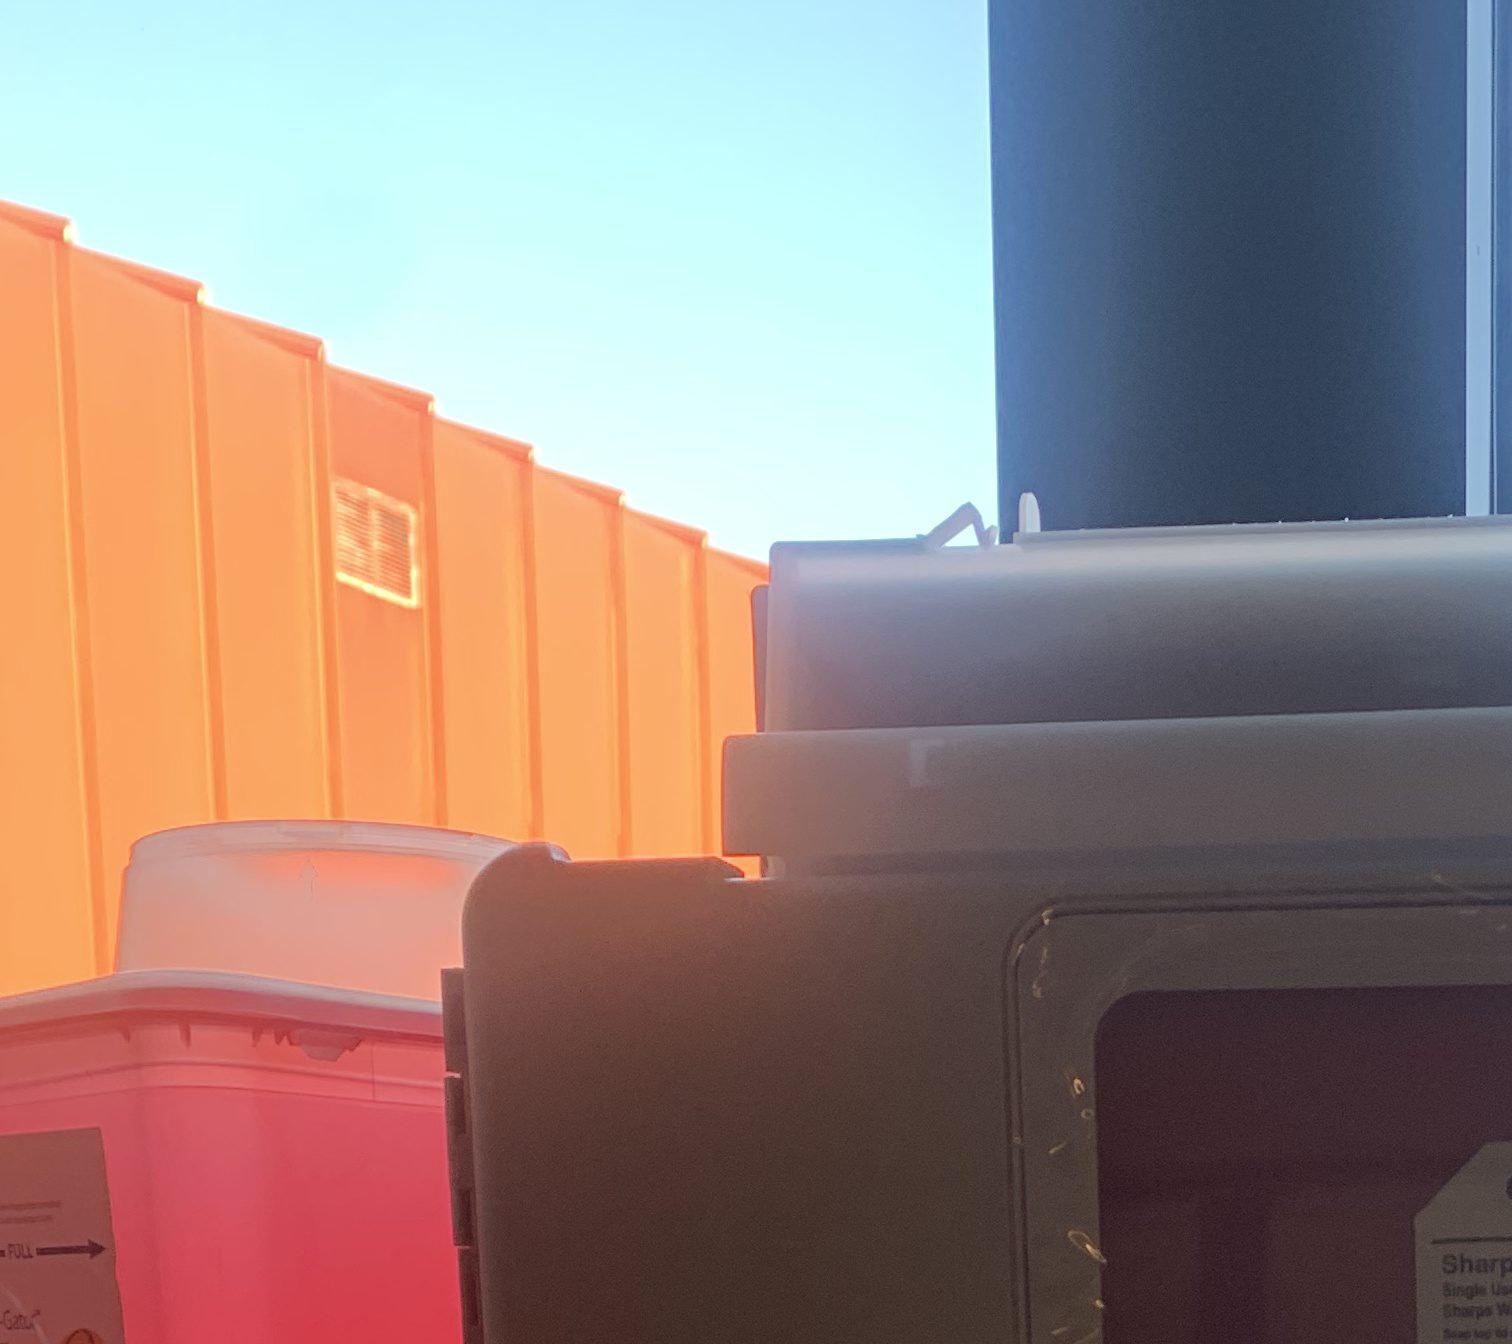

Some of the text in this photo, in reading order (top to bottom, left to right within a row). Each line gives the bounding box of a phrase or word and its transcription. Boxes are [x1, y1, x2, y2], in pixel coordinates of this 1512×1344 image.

[8, 1243, 34, 1259] FULL
[1442, 1281, 1487, 1300] Single
[1442, 1302, 1494, 1320] Sharps
